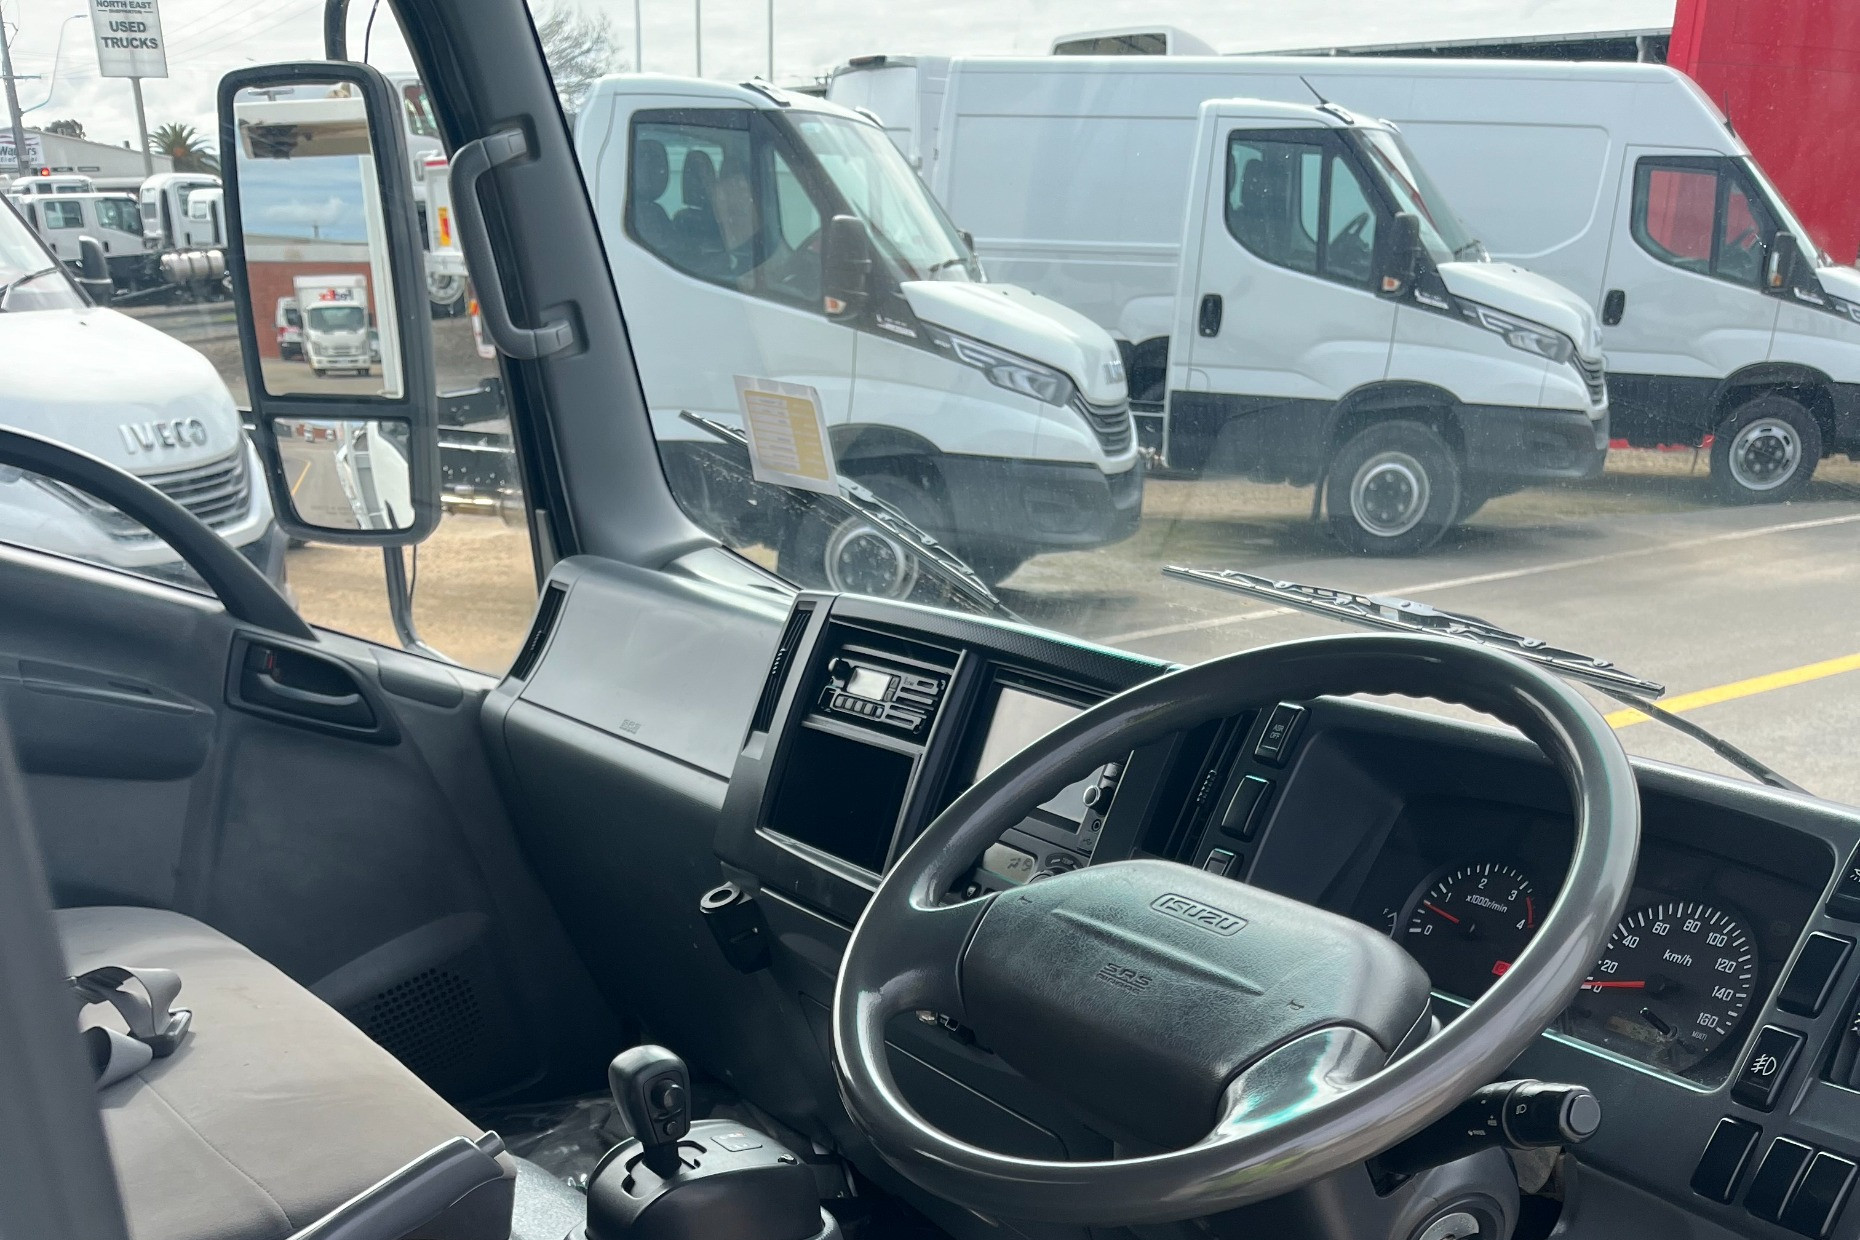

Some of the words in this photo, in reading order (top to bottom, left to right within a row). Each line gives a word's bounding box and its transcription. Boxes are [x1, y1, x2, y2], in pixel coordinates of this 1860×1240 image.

[96, 0, 128, 8] NORTH
[129, 1, 152, 9] EAST
[109, 21, 147, 33] USED
[100, 37, 158, 49] TRUCKS
[118, 419, 207, 455] IVECO
[1478, 878, 1488, 890] 2
[1508, 890, 1518, 902] 3
[1160, 897, 1240, 930] ISUZU
[1423, 924, 1433, 936] 0
[1516, 919, 1526, 931] 4
[1652, 921, 1671, 937] 60
[1682, 919, 1702, 934] 80
[1622, 936, 1640, 949] 40
[1705, 932, 1728, 948] 100
[1662, 949, 1693, 967] km/h
[1714, 957, 1737, 974] 120
[1600, 959, 1619, 974] 20
[1711, 985, 1734, 1002] 140
[1696, 1012, 1719, 1029] 160
